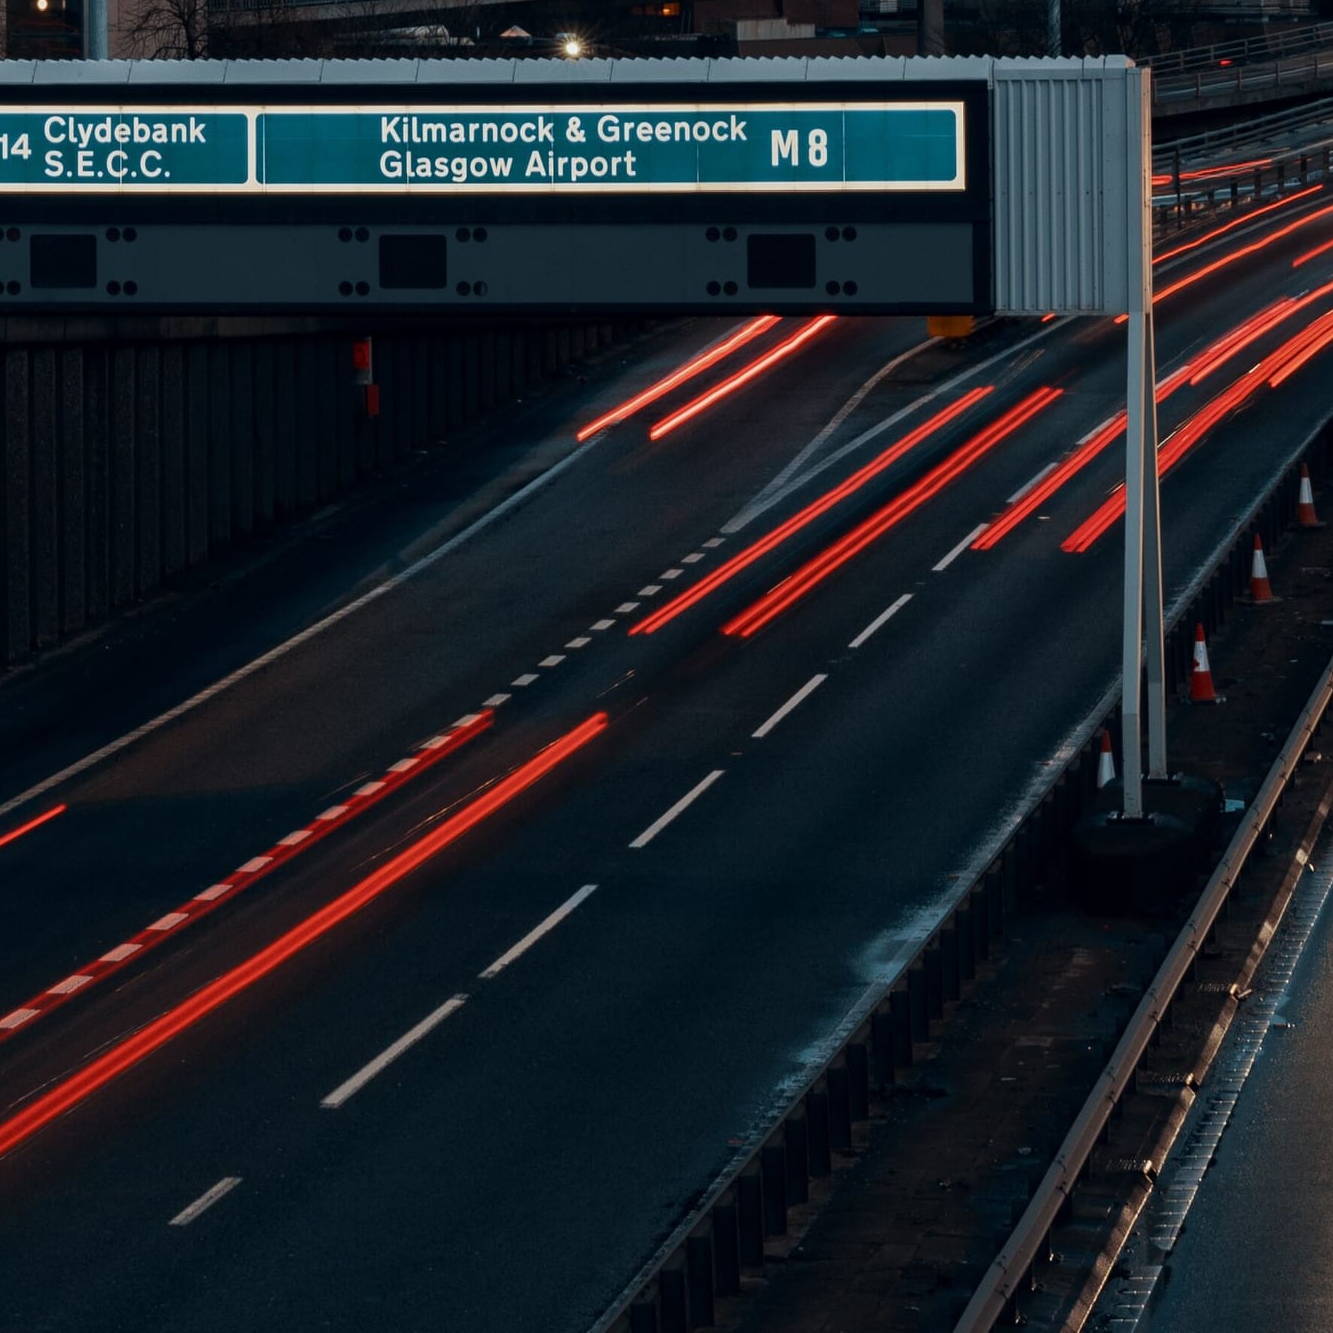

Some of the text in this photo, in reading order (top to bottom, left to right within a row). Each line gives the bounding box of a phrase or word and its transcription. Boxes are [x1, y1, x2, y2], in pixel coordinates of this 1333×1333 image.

[44, 116, 206, 148] Clydebank
[380, 114, 748, 143] Kilmarnock & Greenock
[44, 150, 171, 178] S.E.C.C.
[379, 150, 637, 182] Glasgow Airport
